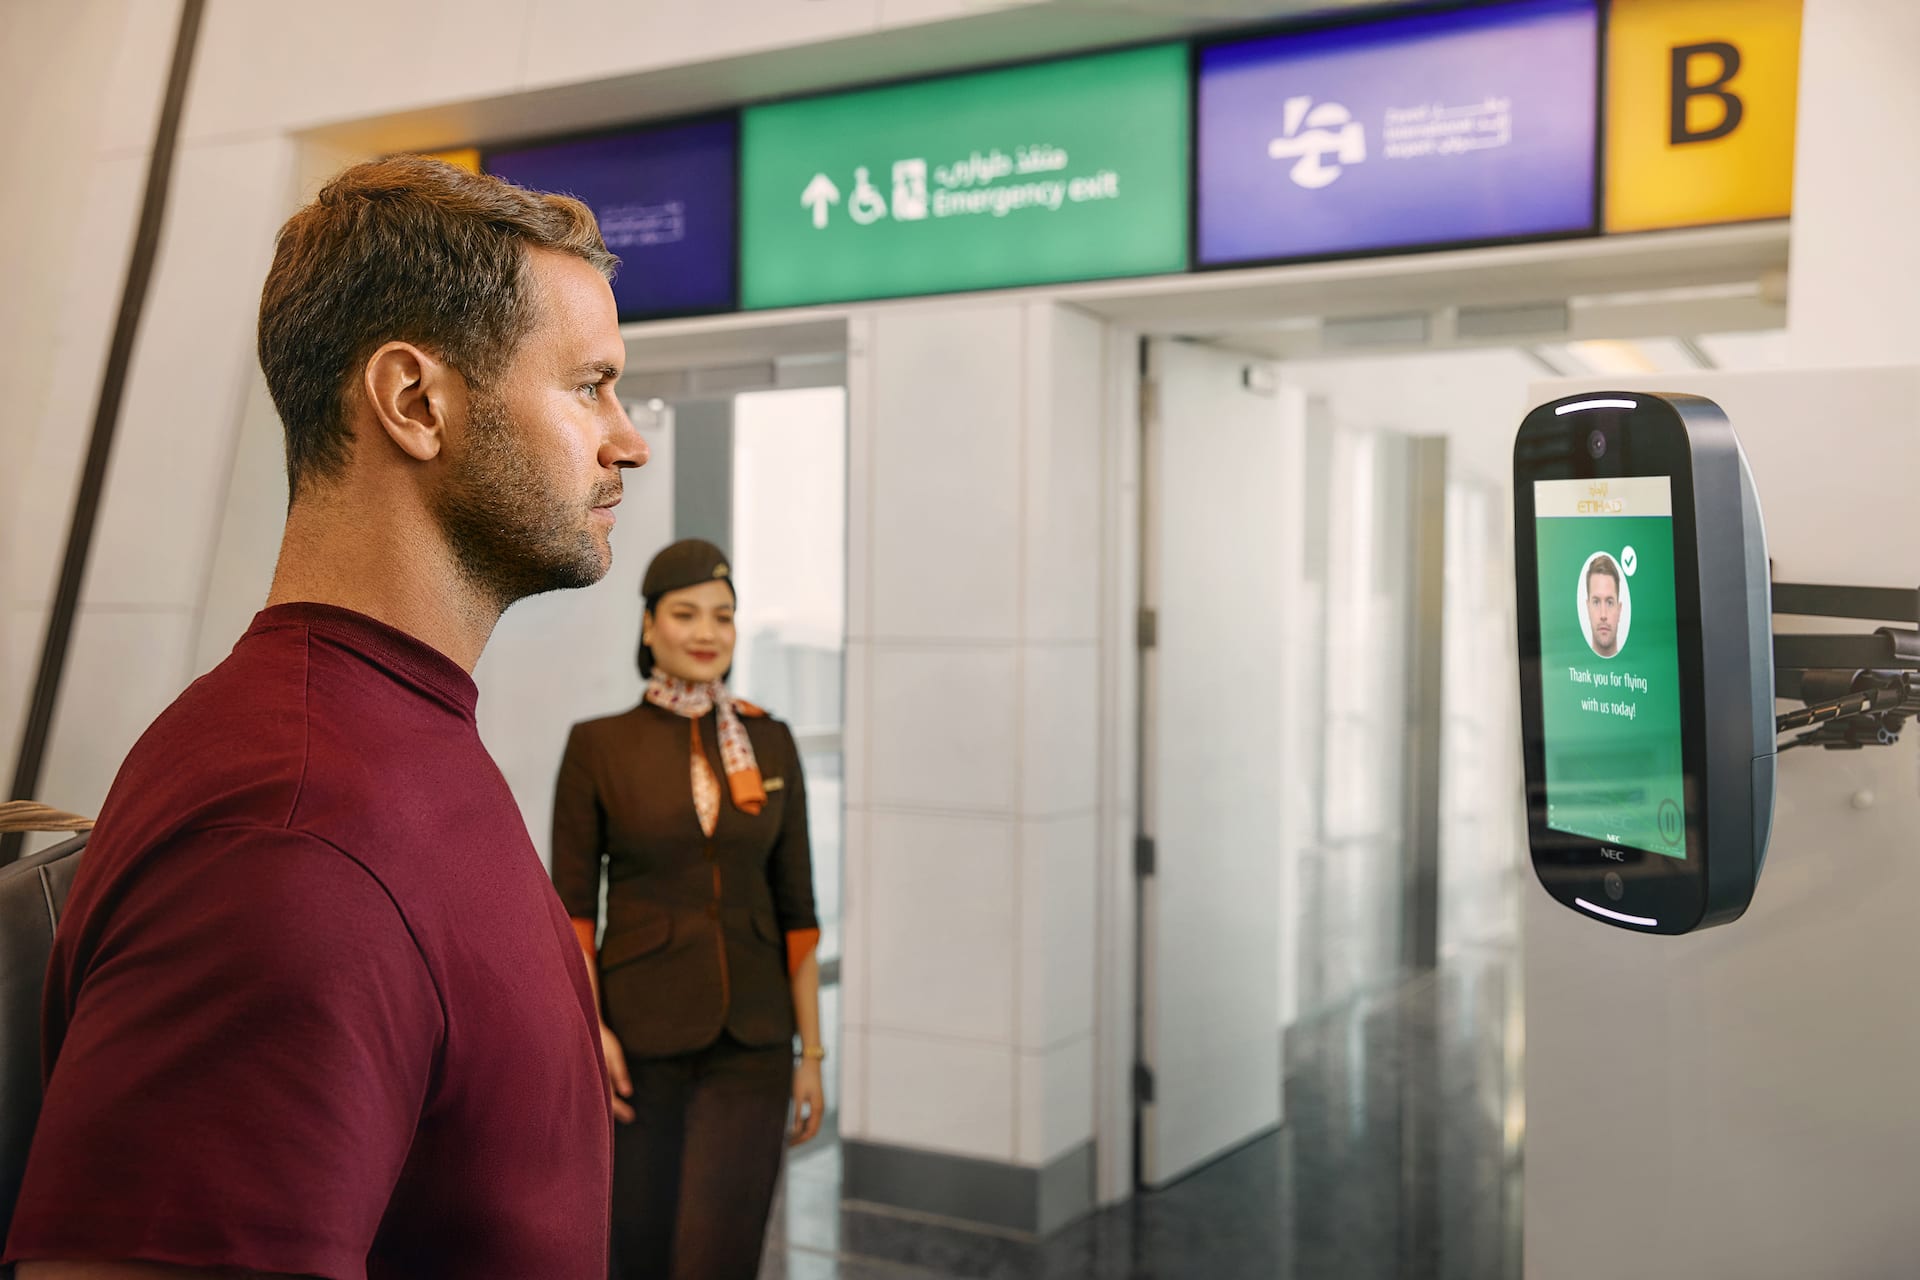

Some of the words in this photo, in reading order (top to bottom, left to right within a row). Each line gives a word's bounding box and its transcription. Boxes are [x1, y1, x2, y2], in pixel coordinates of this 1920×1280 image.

[1670, 41, 1743, 145] B
[933, 179, 1067, 217] Emergency
[1068, 170, 1120, 202] exit
[1568, 667, 1592, 683] Thank
[1593, 673, 1608, 688] you
[1610, 671, 1622, 687] for
[1624, 672, 1648, 694] flying
[1581, 697, 1599, 712] with
[1600, 702, 1610, 714] us
[1611, 701, 1636, 720] today!
[1606, 833, 1621, 844] NEC
[1600, 847, 1625, 862] NEC
